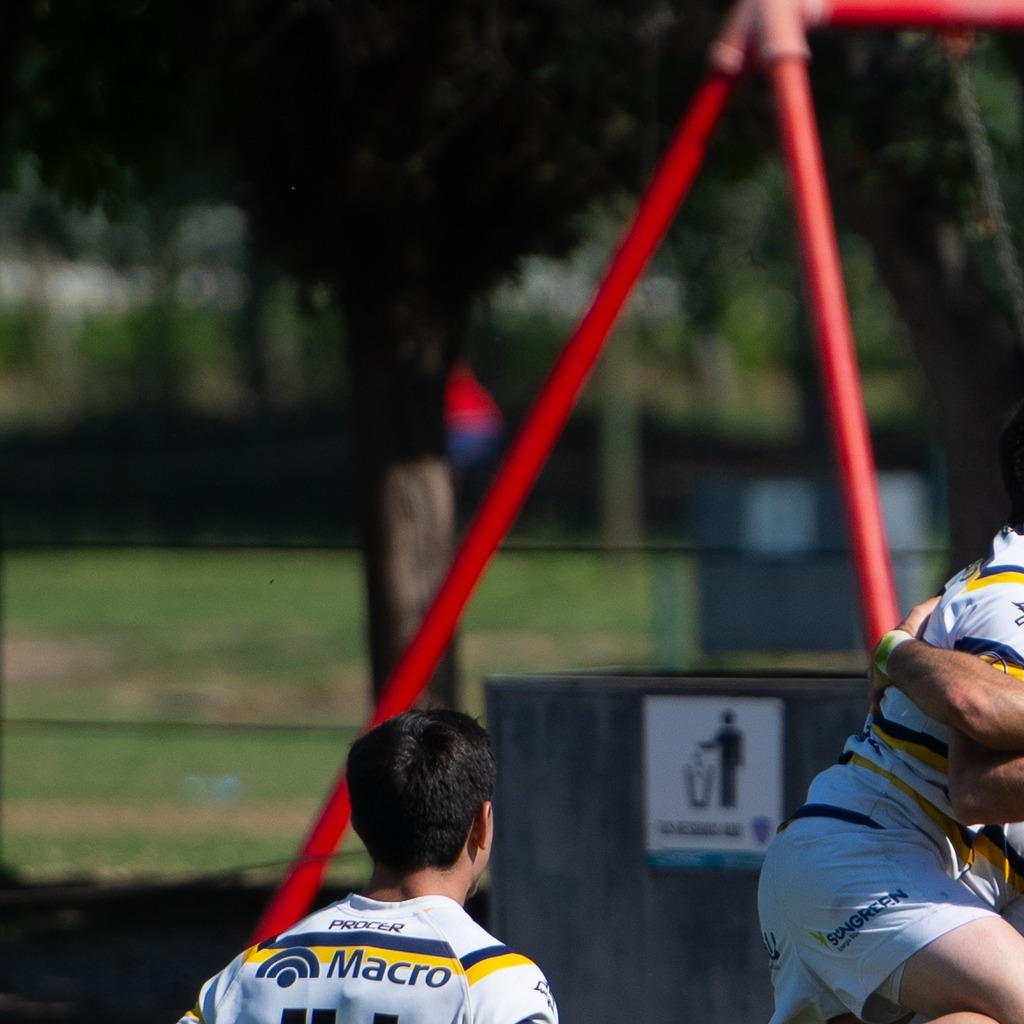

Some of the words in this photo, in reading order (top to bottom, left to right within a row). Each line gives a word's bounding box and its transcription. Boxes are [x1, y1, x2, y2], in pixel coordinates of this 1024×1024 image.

[328, 919, 405, 933] PROCER
[826, 889, 909, 946] SUNGREEN
[327, 949, 451, 988] Macro
